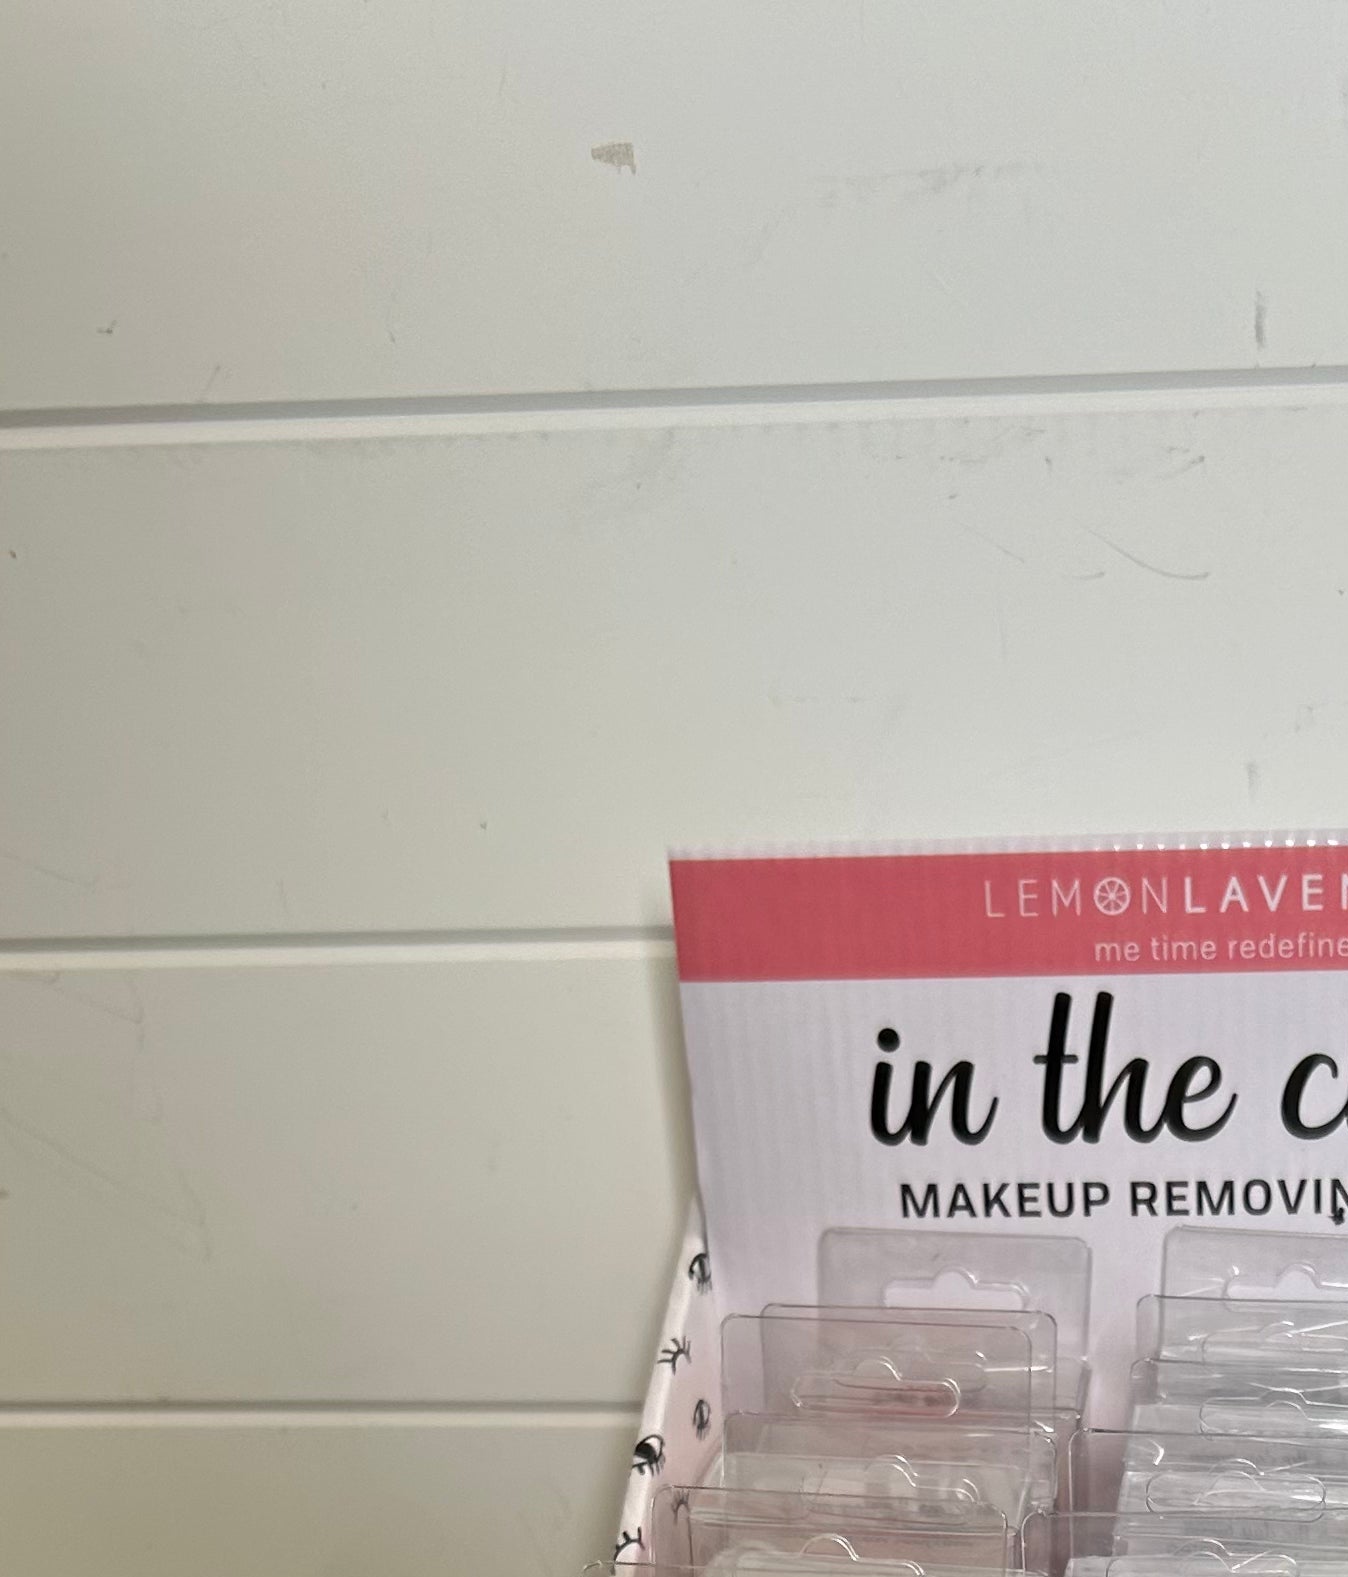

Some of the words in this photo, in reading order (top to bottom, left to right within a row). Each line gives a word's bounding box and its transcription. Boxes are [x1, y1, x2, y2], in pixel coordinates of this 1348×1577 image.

[1094, 940, 1139, 962] me
[1150, 935, 1217, 962] time
[868, 1027, 999, 1146] in
[1033, 990, 1238, 1145] the
[900, 1181, 1110, 1219] MAKEUP
